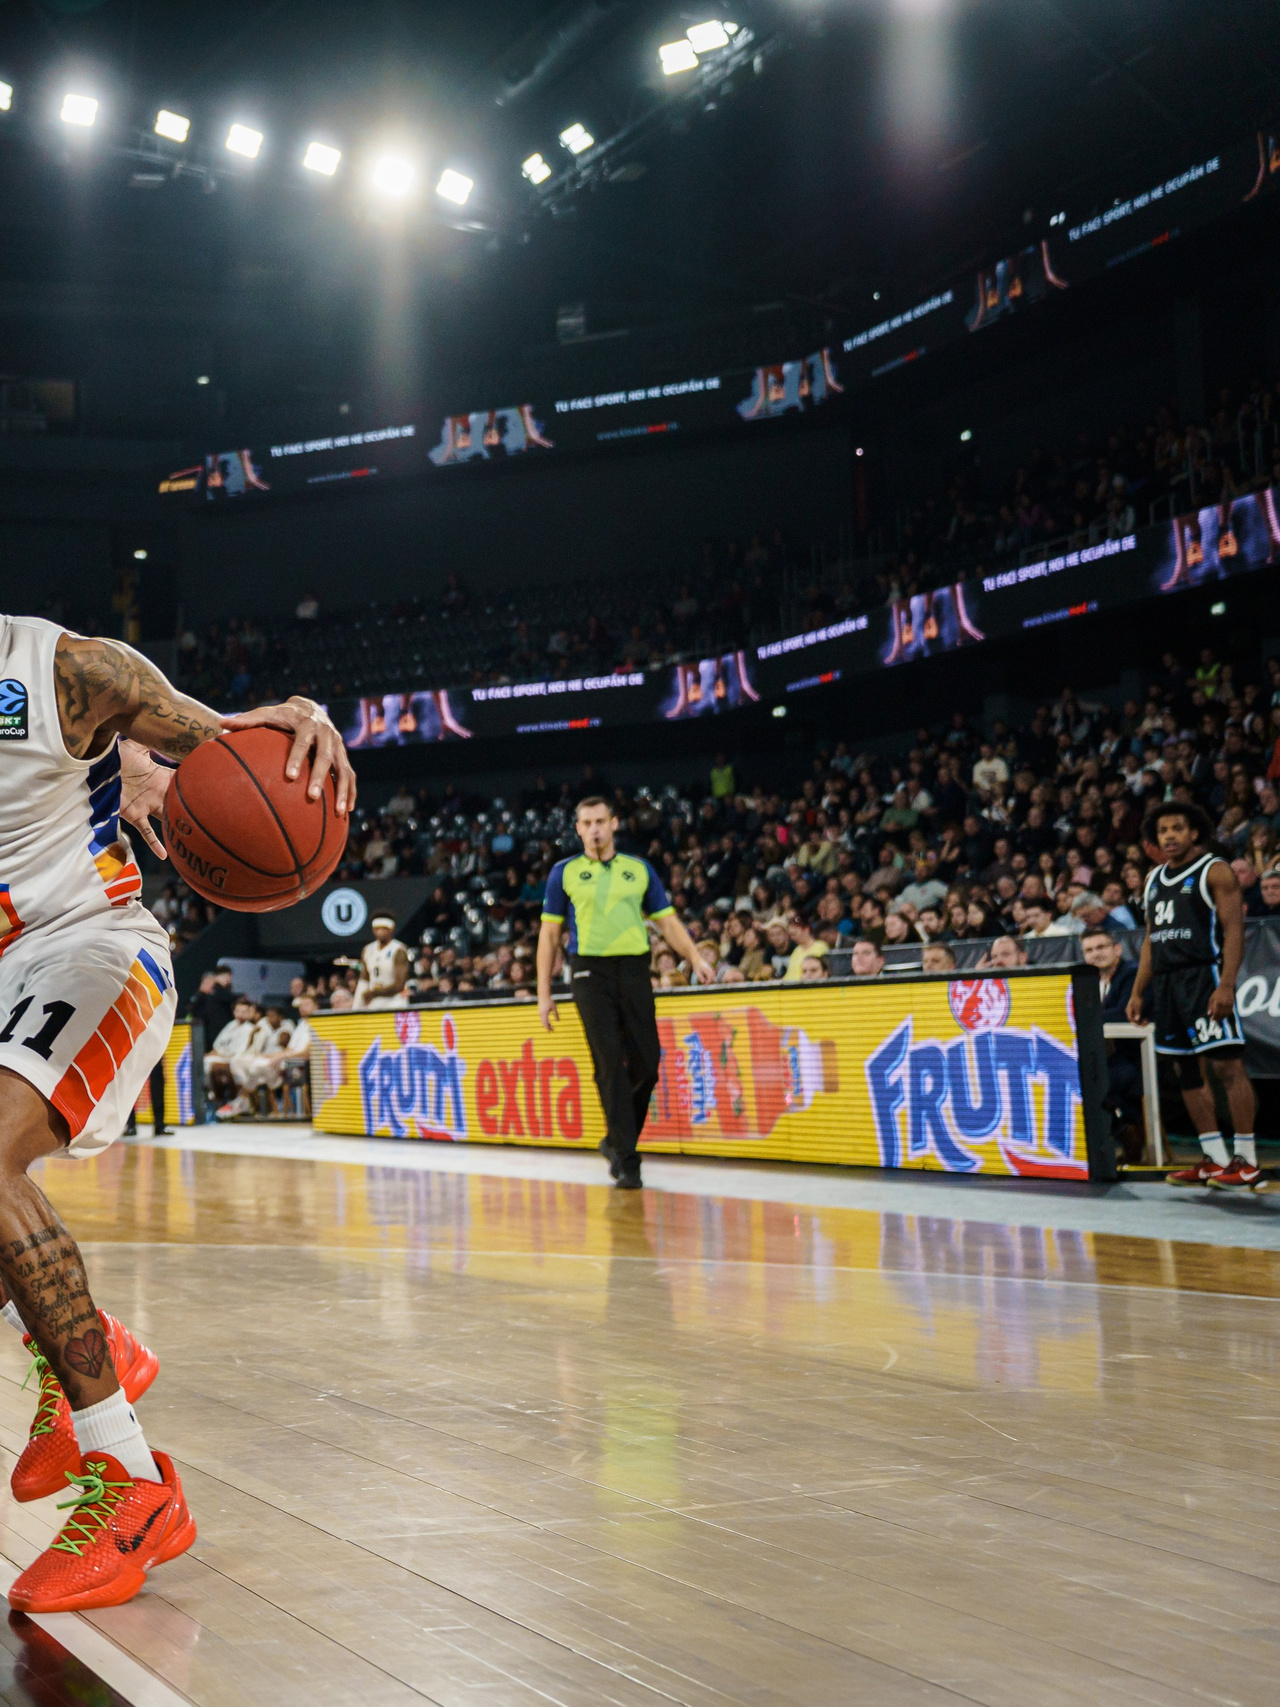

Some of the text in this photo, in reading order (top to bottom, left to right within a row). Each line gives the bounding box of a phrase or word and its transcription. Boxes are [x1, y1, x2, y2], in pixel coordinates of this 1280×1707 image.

[1069, 225, 1079, 242] TU
[1081, 214, 1100, 236] FACI
[1150, 184, 1162, 202] NE
[1205, 156, 1218, 175] DE
[554, 400, 568, 413] TU
[570, 396, 592, 410] FACI
[627, 388, 644, 401] NOI
[647, 386, 660, 398] NE
[705, 377, 719, 389] DE
[983, 575, 995, 592] TU
[996, 569, 1016, 588] FACI
[1017, 560, 1048, 583] SPORT,
[1048, 555, 1064, 573] NOI
[1065, 551, 1078, 568] NE
[1120, 535, 1135, 552] DE
[472, 688, 486, 701] TU
[487, 685, 510, 700] FACI
[512, 682, 547, 698] SPORT,
[547, 680, 566, 694] NOI
[567, 678, 582, 692] NE
[628, 672, 643, 685] DE
[335, 903, 352, 922] U
[1154, 900, 1175, 926] 34
[1195, 1017, 1223, 1043] 34
[476, 1038, 583, 1139] extra
[865, 1016, 1081, 1170] FRUTT
